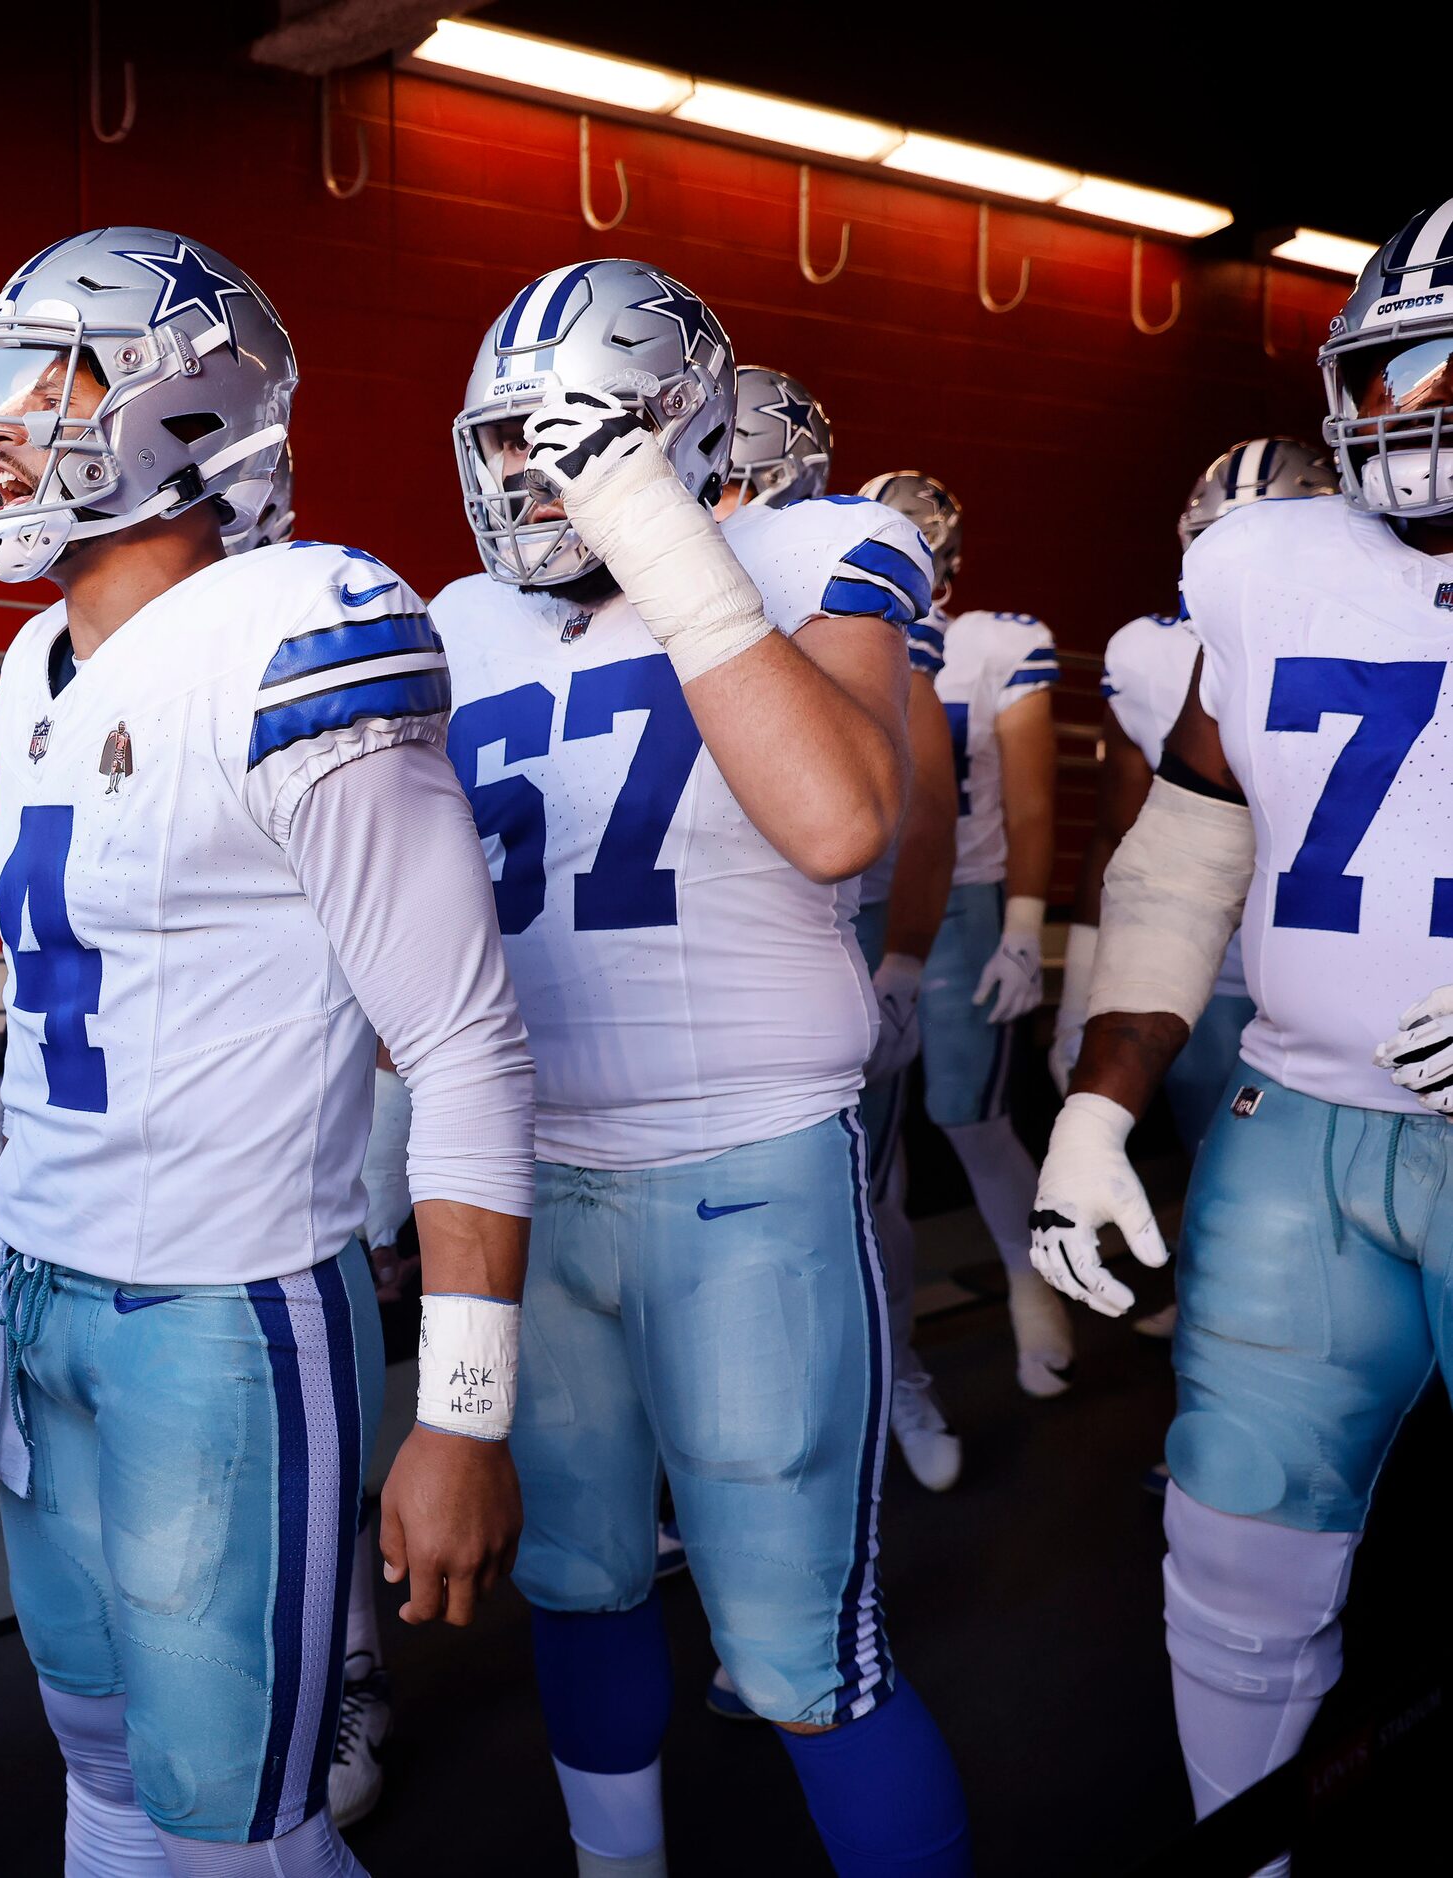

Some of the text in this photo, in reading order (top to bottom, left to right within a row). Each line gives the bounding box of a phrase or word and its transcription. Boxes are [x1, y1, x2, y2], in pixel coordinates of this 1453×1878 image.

[1377, 293, 1444, 315] COWBOYS
[493, 377, 545, 395] COWBOYS
[445, 652, 704, 936] 67
[1264, 656, 1453, 938] 7
[463, 1387, 477, 1399] 4
